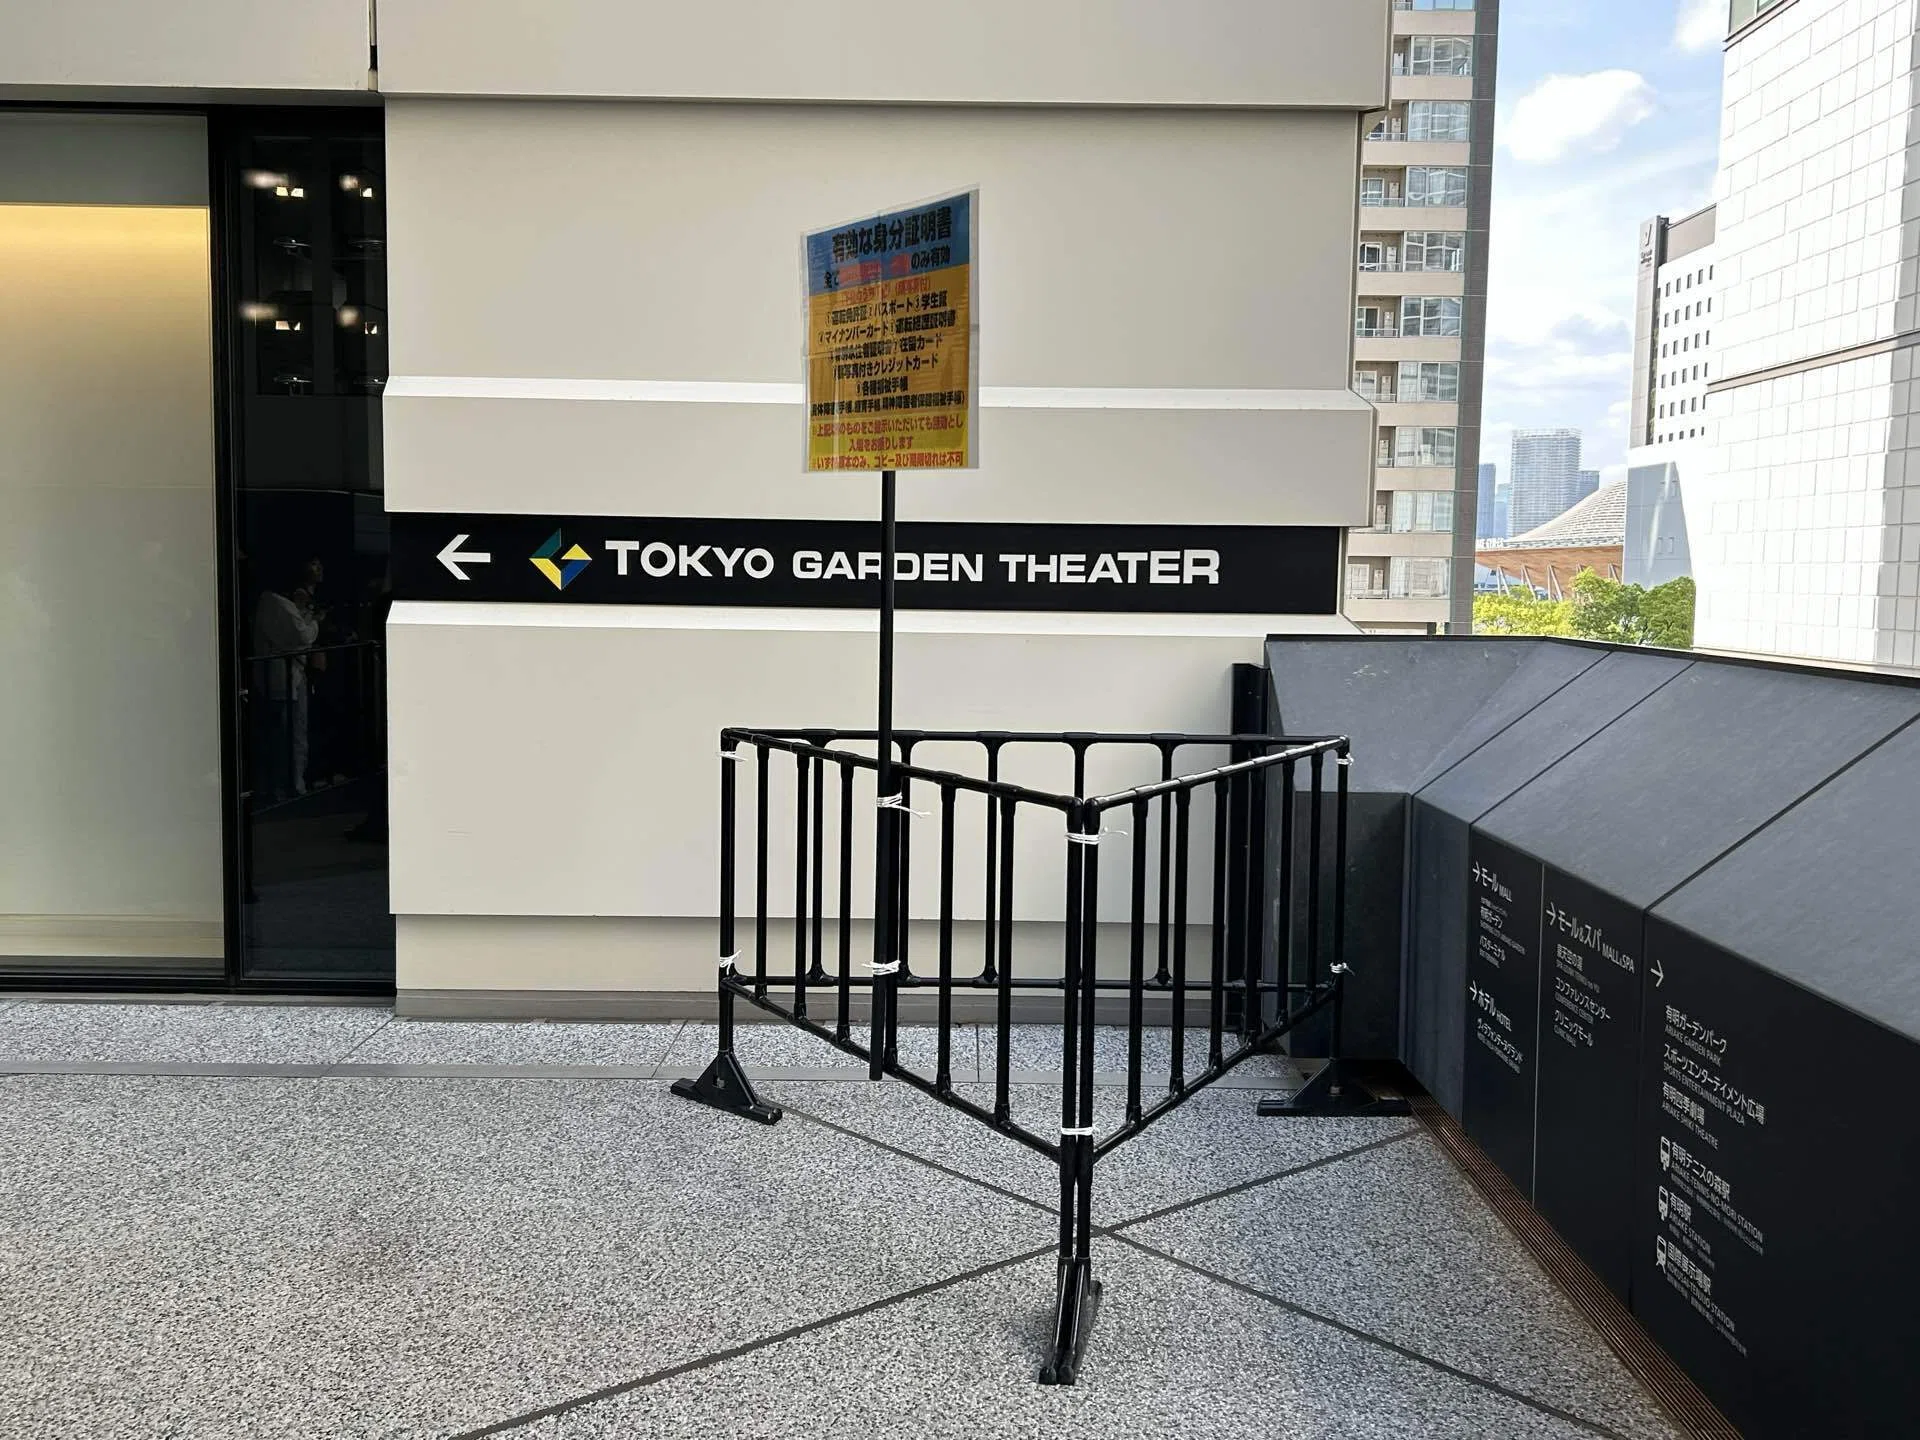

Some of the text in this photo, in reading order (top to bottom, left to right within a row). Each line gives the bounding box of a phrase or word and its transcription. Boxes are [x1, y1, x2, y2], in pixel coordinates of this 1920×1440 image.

[832, 206, 952, 264] 有効な身分証明書
[605, 540, 1221, 585] TOKYO GARDEN THEATER
[1480, 866, 1499, 893] モール
[1665, 1004, 1727, 1054] 有明ガーデンパーク
[1663, 1043, 1765, 1126] スポーツエンターテイメント広場
[1671, 1141, 1731, 1202] 有明テニスの森駅
[1669, 1191, 1692, 1223] 有明駅
